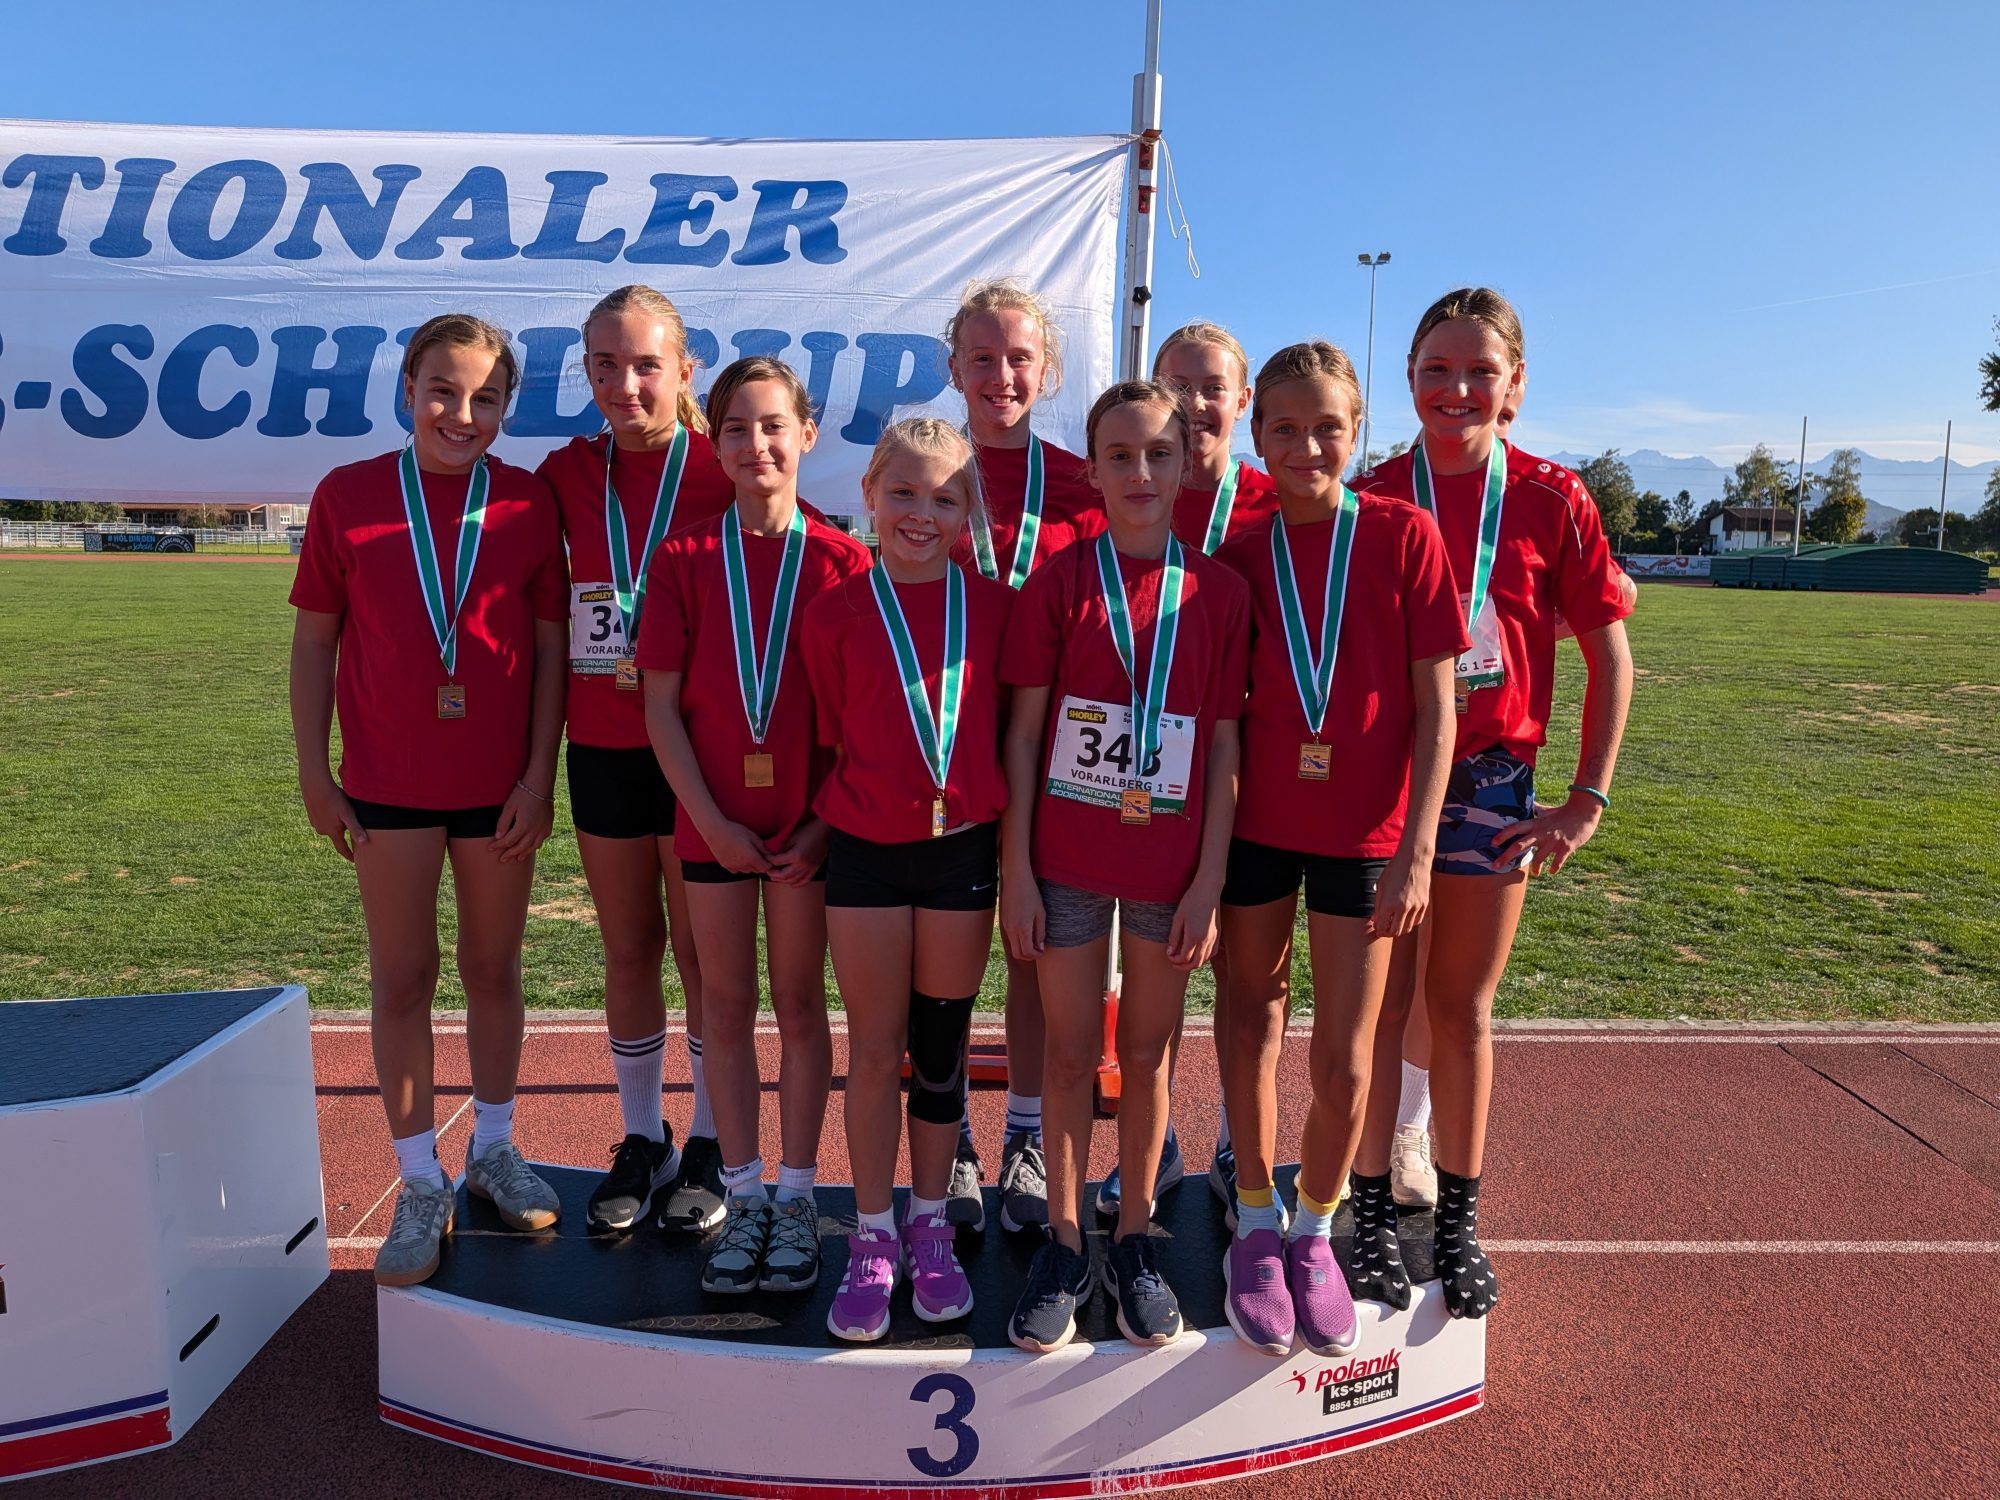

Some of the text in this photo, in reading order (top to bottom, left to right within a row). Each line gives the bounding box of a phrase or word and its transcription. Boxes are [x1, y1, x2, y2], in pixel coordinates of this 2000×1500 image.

[2, 153, 848, 267] TIONALER
[581, 591, 613, 601] SHORLEY
[586, 645, 636, 655] VORARLB
[1473, 661, 1479, 670] 1
[1068, 708, 1106, 724] SHORLEY
[1053, 780, 1122, 801] INTERNATIONAL
[1071, 768, 1164, 793] VORARLBERG 1
[1314, 1348, 1402, 1393] polanik
[1330, 1371, 1393, 1399] ks-sport
[1329, 1388, 1393, 1412] 8854 SIEBNEN
[907, 1372, 980, 1478] 3
